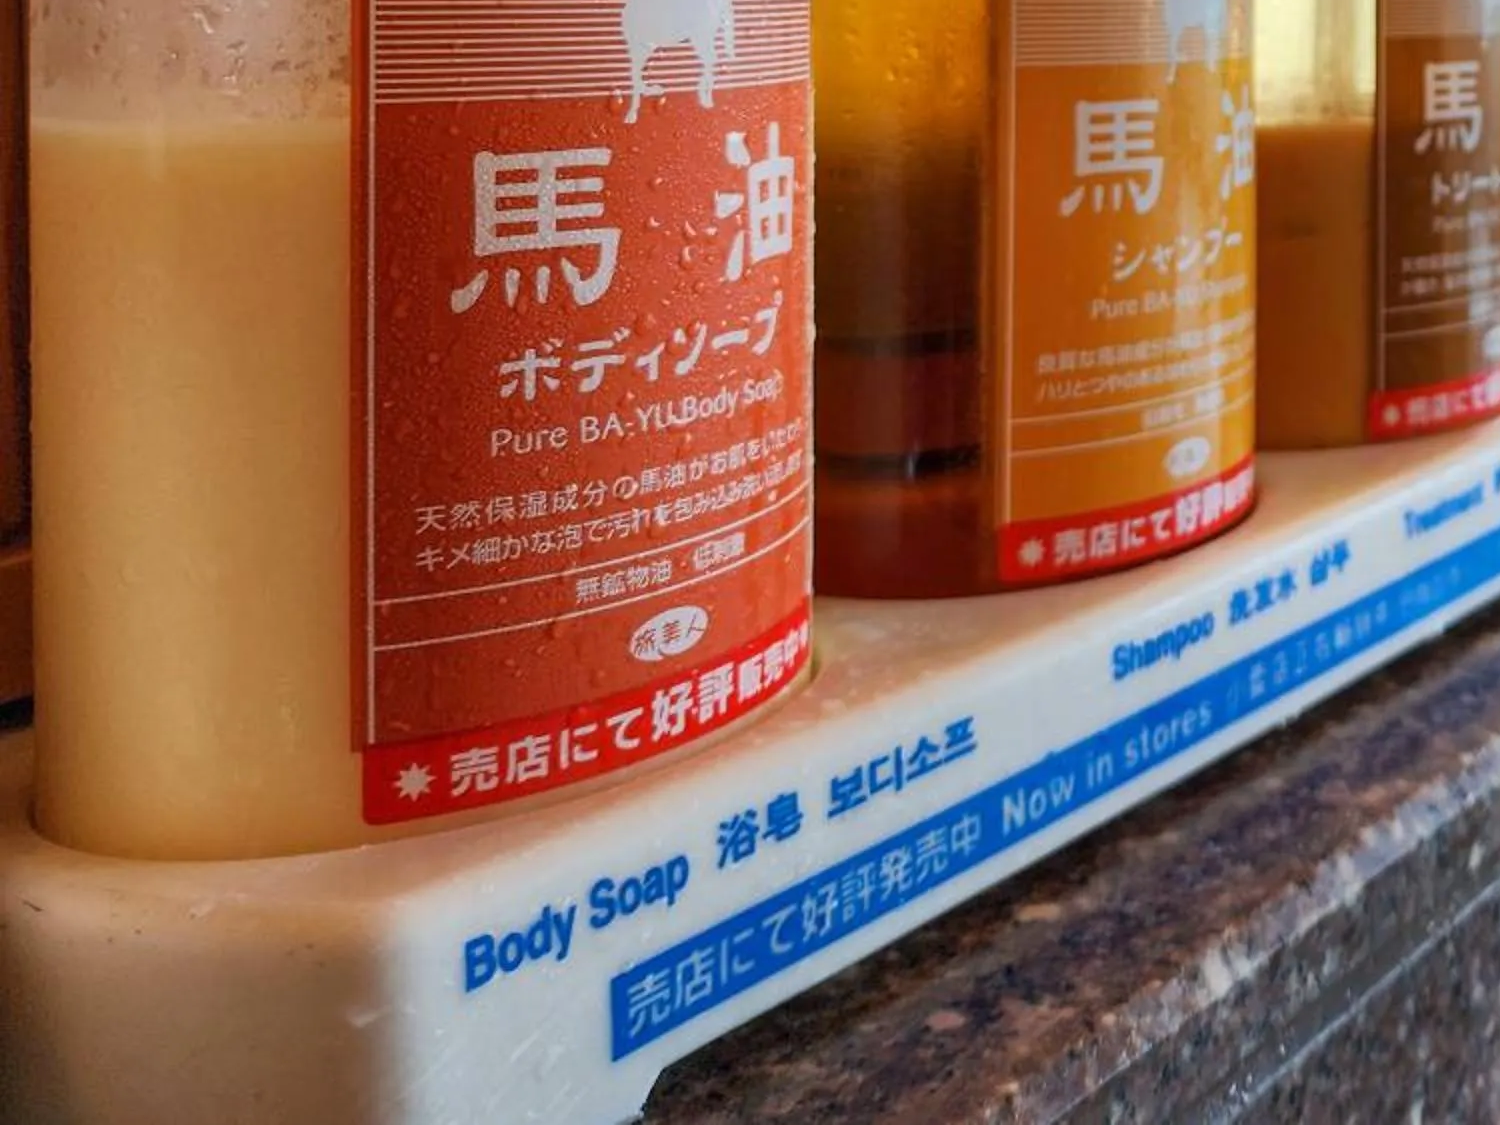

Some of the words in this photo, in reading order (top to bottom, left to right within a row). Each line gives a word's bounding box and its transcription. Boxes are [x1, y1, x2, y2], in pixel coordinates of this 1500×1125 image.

[451, 121, 796, 314] 馬油
[491, 422, 569, 457] Pure
[681, 384, 740, 424] Body
[742, 371, 784, 406] Soap
[500, 290, 784, 401] ボディソープ
[1111, 611, 1215, 682] Shampoo
[464, 904, 577, 993] Body
[589, 854, 690, 930] Soap
[827, 715, 977, 819] 보디소프
[627, 812, 983, 1040] 売店にて好評発売中
[1002, 771, 1075, 834] Now
[1086, 751, 1113, 790] in
[1124, 699, 1212, 767] stores
